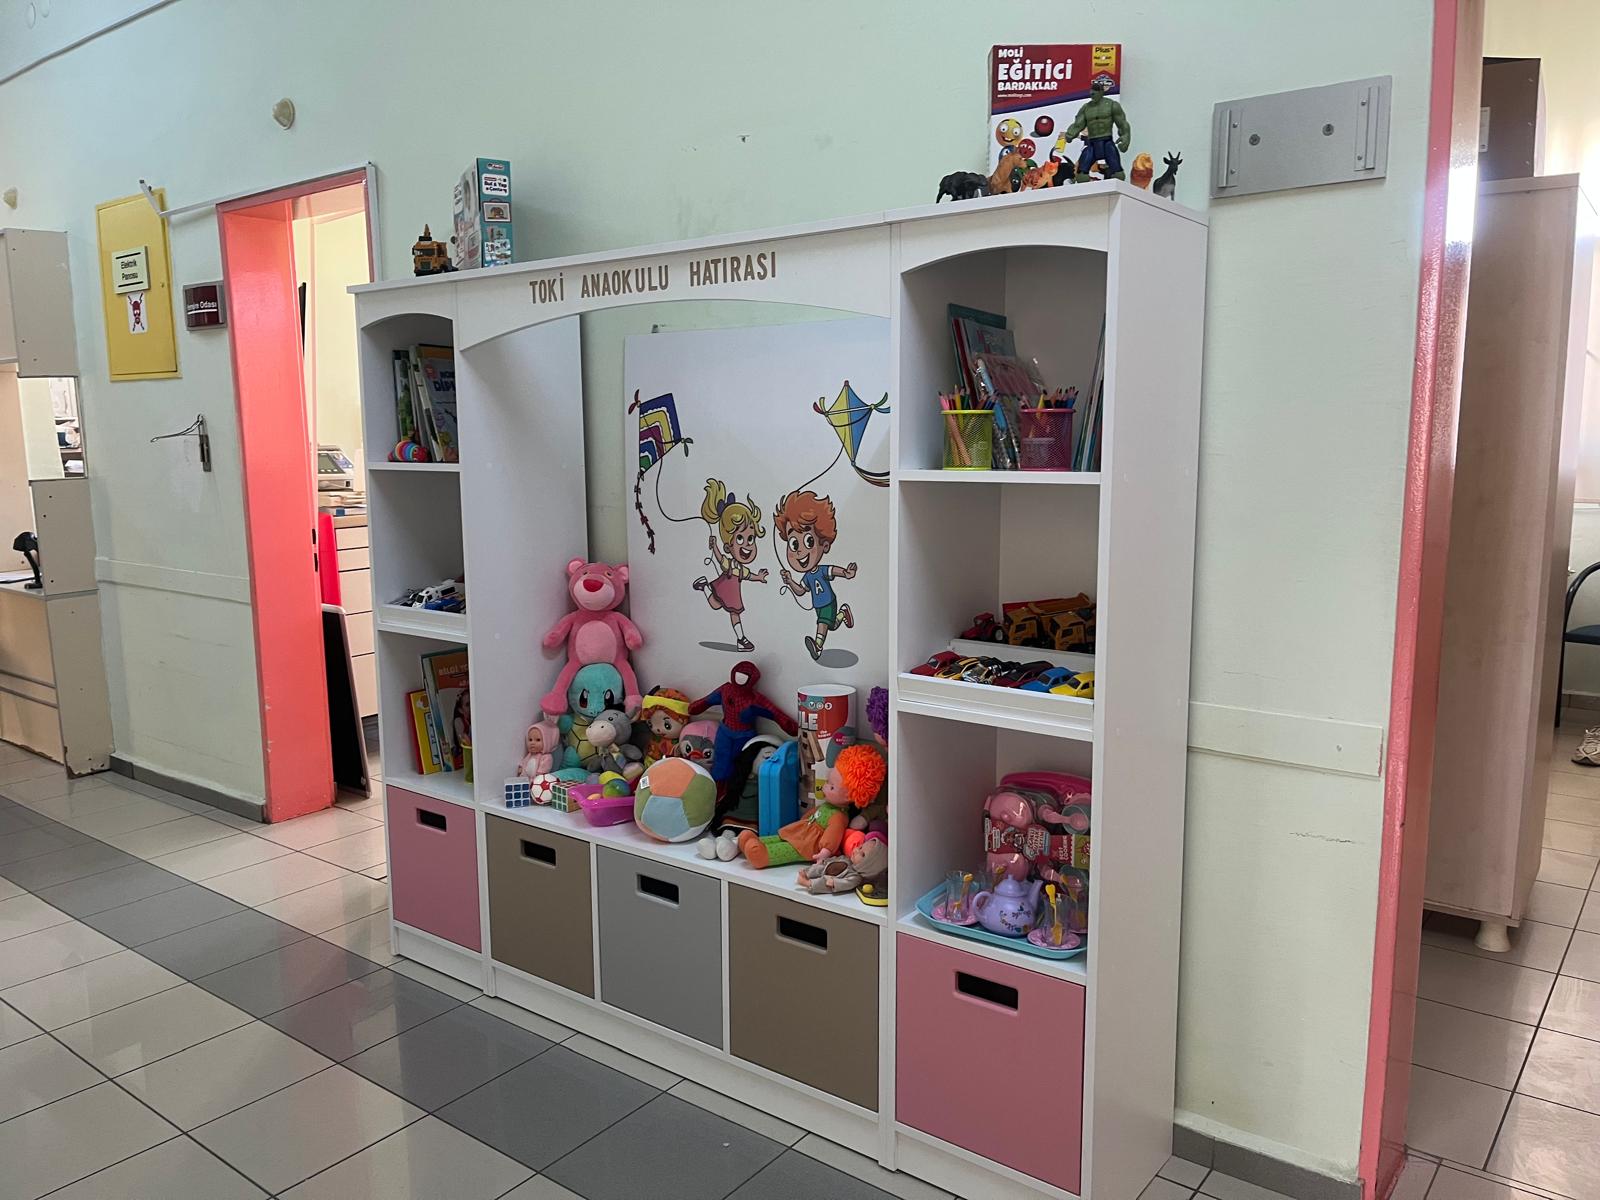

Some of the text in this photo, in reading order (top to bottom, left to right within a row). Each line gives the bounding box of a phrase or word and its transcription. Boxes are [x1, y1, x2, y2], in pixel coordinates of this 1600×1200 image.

[998, 47, 1023, 58] MOLİ
[998, 58, 1073, 81] EĞİTİCİ
[997, 81, 1058, 92] BARDAKLAR
[529, 251, 776, 304] TOKİ ANAOKULU HATIRASI
[815, 579, 824, 595] A
